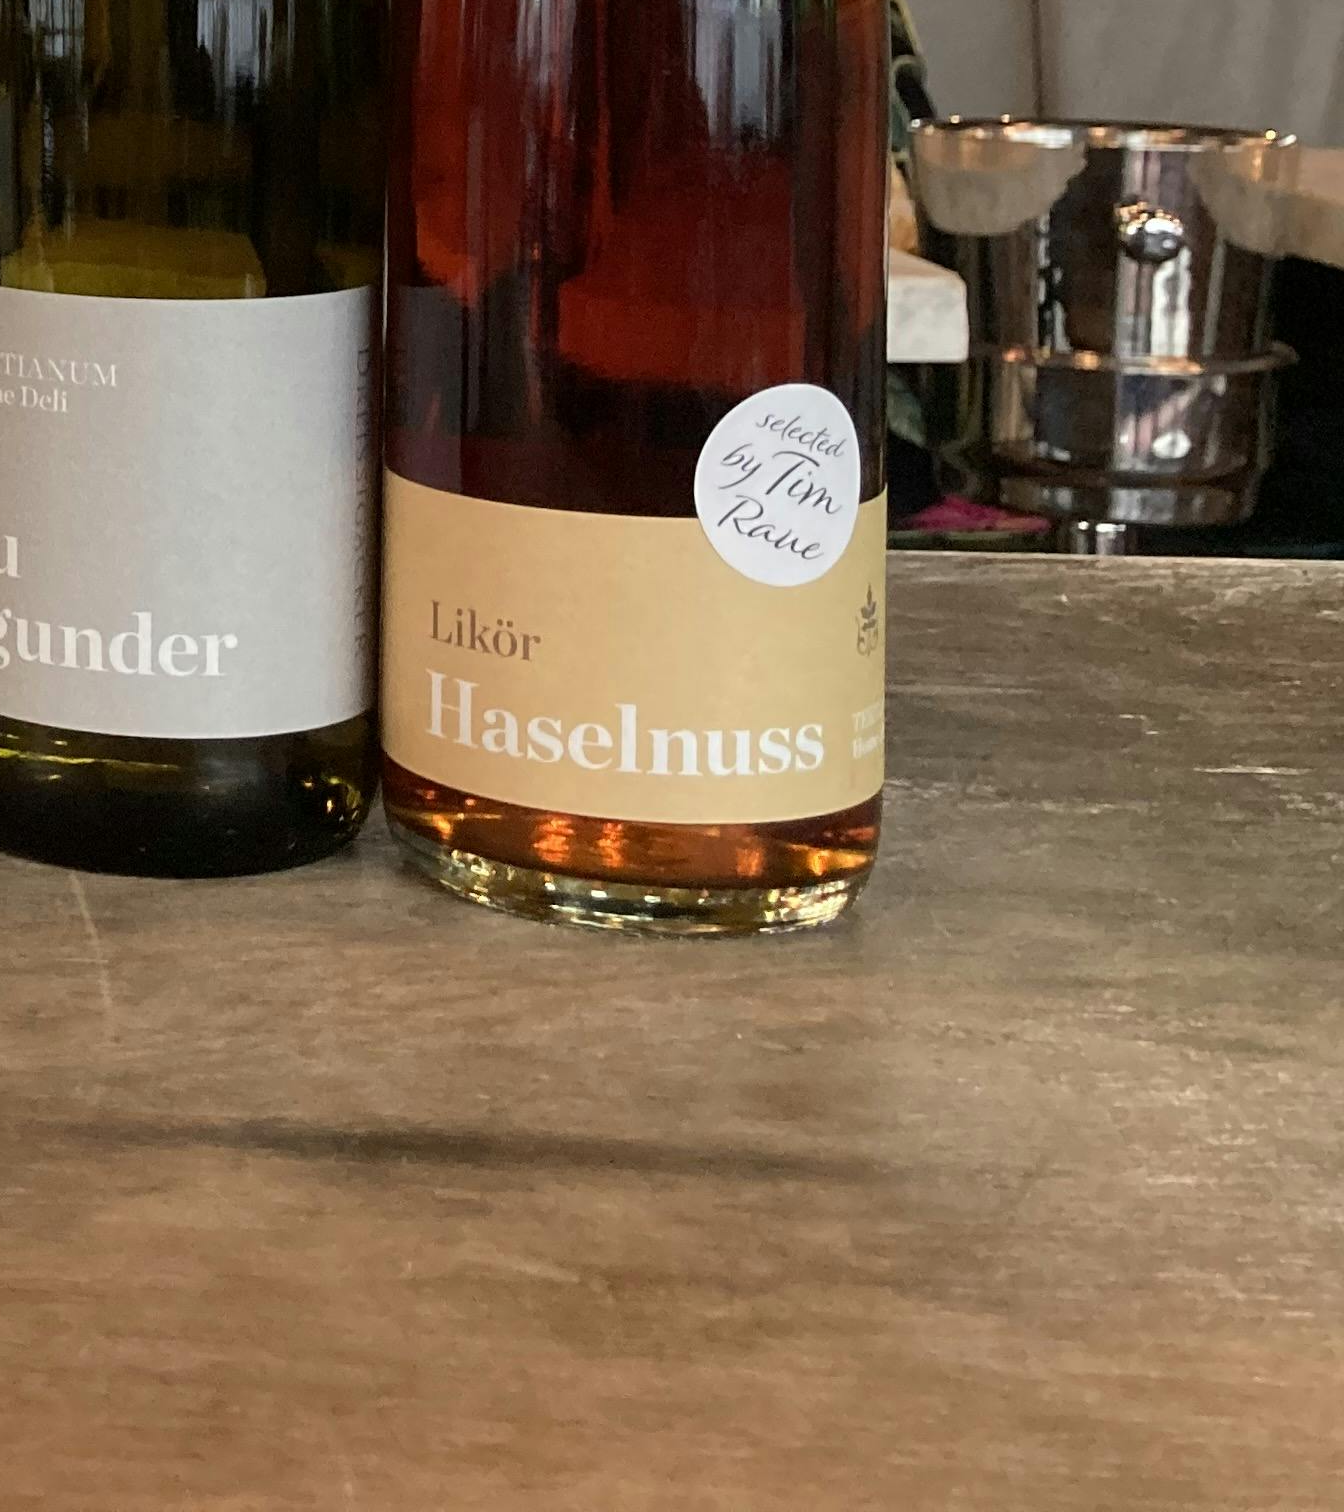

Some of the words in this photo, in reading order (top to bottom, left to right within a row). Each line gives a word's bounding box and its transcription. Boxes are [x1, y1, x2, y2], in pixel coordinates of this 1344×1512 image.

[21, 386, 69, 413] Deli
[754, 410, 845, 458] selected
[718, 442, 761, 491] by
[765, 450, 843, 516] Tim
[717, 494, 825, 562] Raue
[429, 599, 542, 662] Likör
[424, 667, 826, 777] Haselnuss
